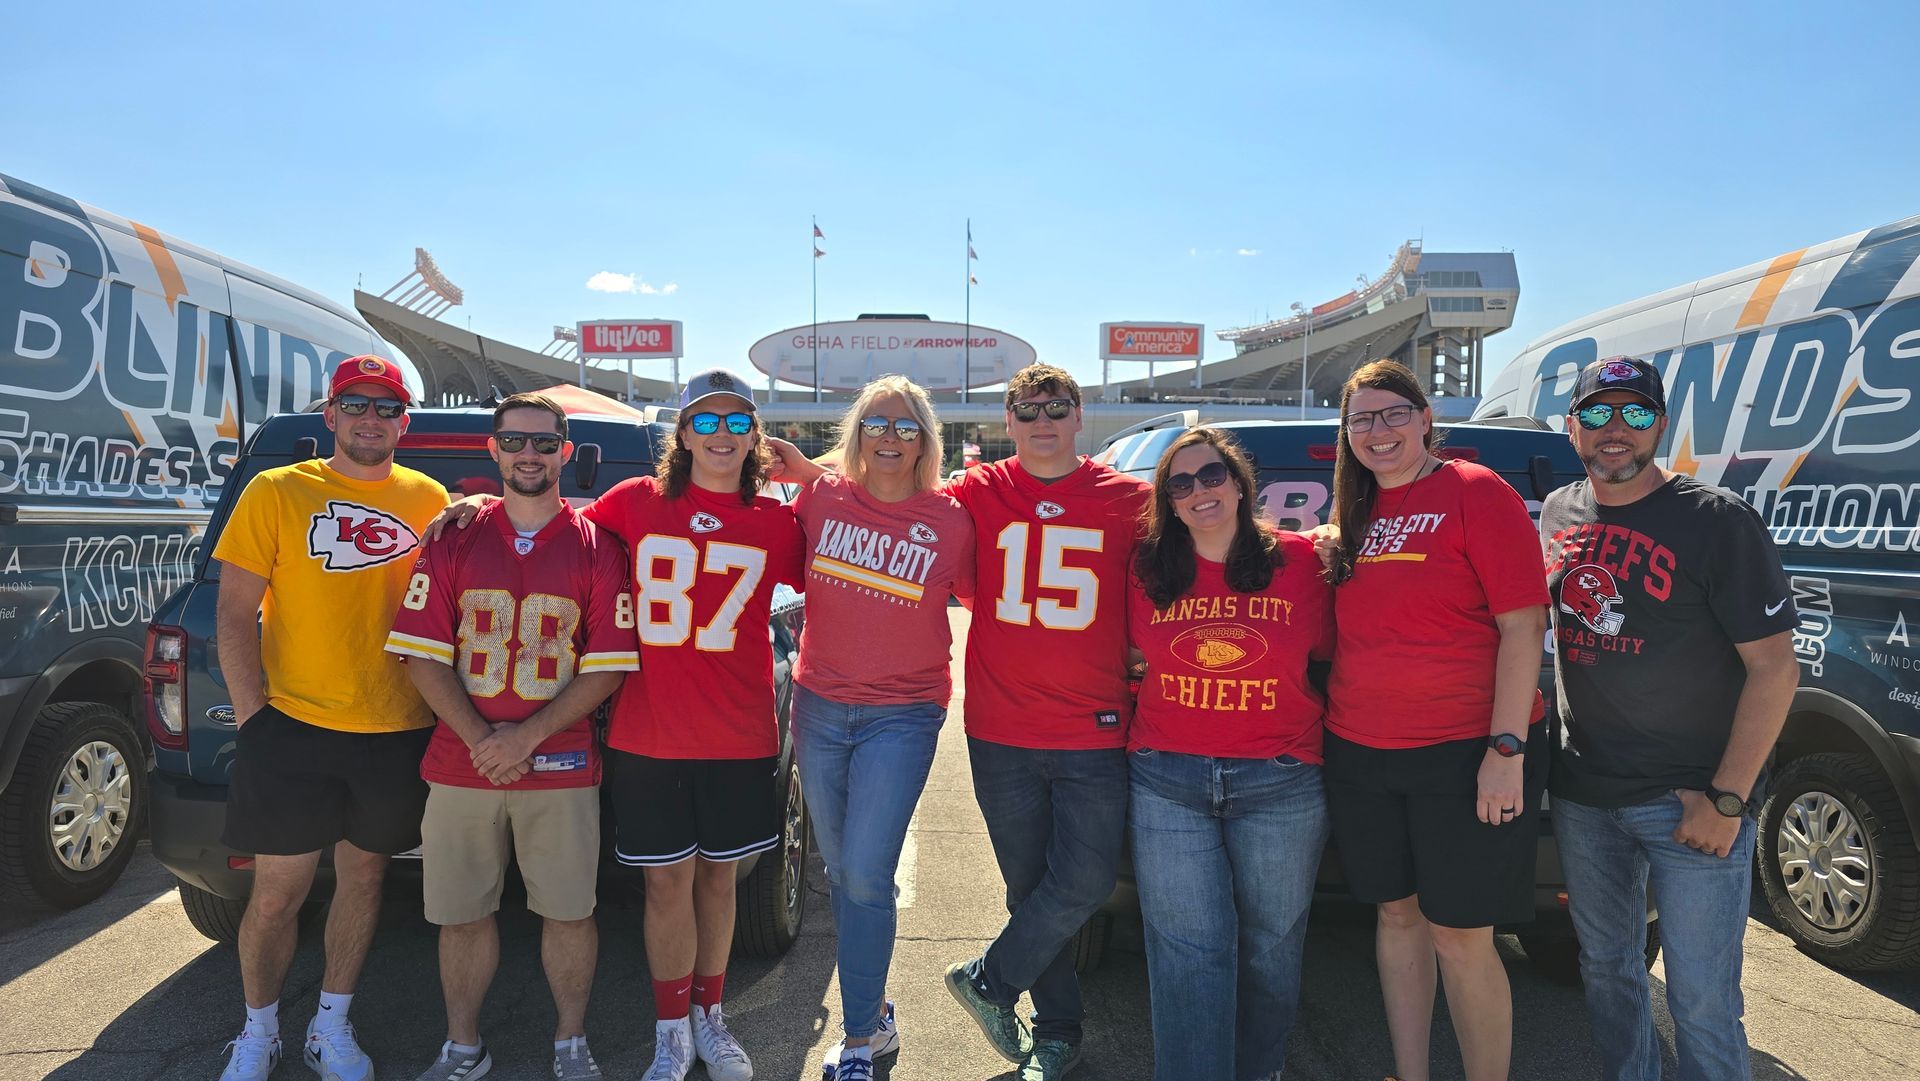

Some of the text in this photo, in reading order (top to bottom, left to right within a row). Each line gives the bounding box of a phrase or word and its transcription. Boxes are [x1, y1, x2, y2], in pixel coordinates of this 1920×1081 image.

[792, 335, 844, 349] GEHA
[851, 335, 900, 350] FIELD
[913, 337, 998, 349] ARROWHEAD
[1114, 328, 1194, 345] Community
[336, 516, 398, 556] KC
[1402, 513, 1447, 533] CITY
[815, 518, 938, 585] KANSAS CITY
[402, 572, 430, 611] 8
[636, 533, 768, 652] 87
[808, 571, 919, 609] CHIEFS FOOTBALL
[996, 521, 1105, 631] 15
[614, 592, 635, 629] 8
[1150, 596, 1294, 626] KANSAS CITY
[456, 588, 582, 701] 88
[1601, 634, 1645, 655] CITY
[1160, 673, 1279, 712] CHIEFS
